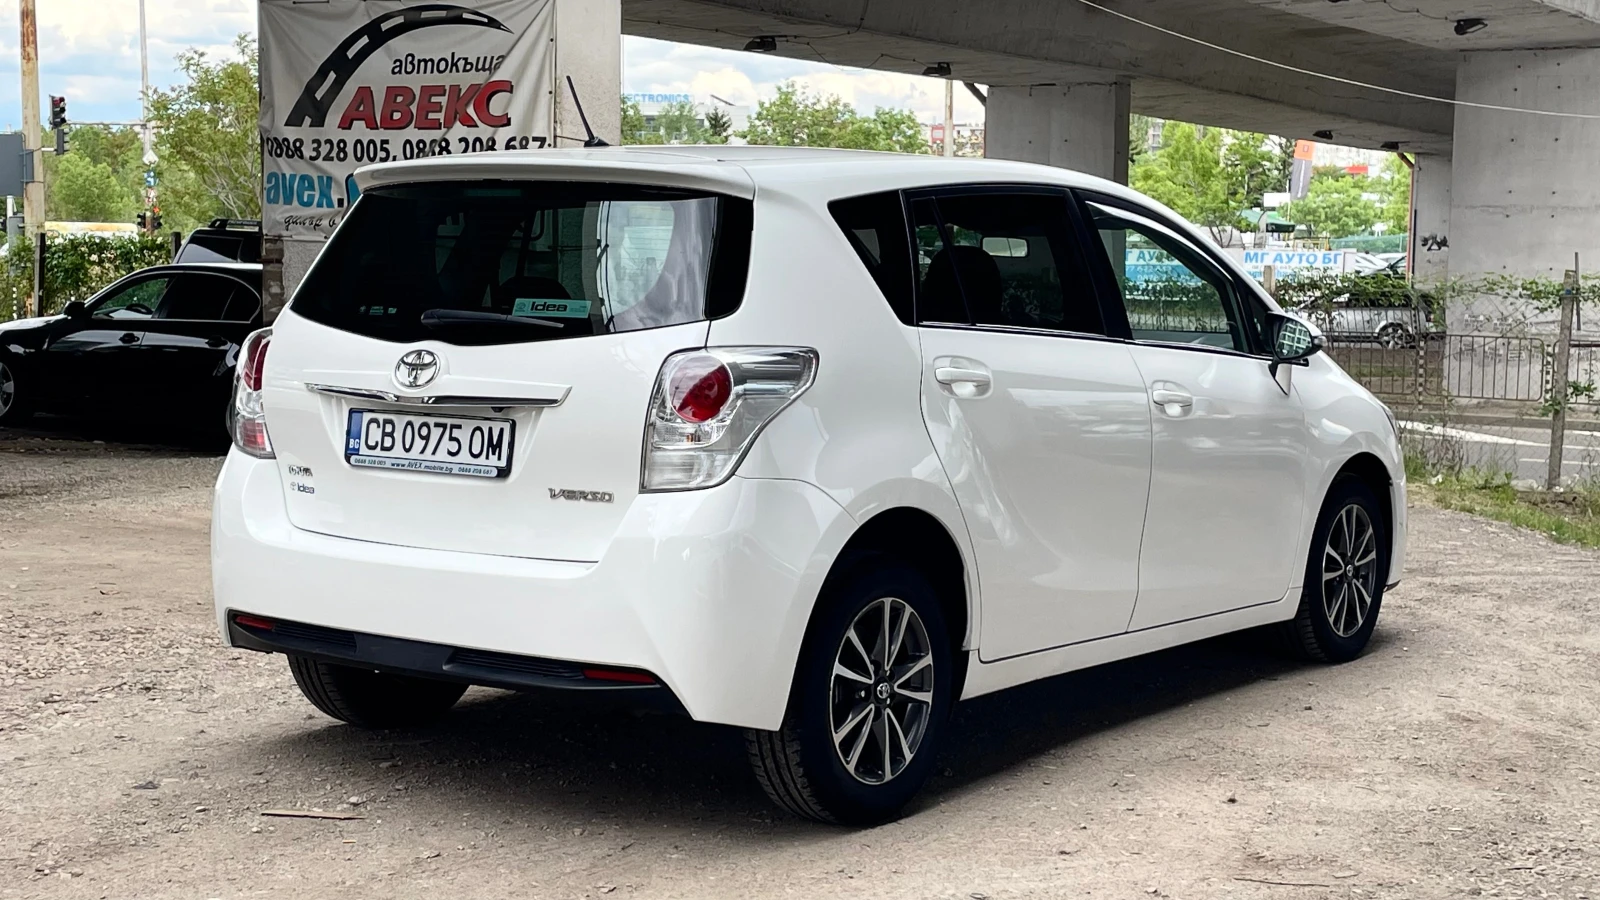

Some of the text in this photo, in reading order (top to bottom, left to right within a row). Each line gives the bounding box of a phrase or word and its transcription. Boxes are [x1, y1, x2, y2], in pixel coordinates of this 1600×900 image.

[391, 52, 506, 76] автокъща
[337, 80, 513, 130] АВЕКС
[265, 136, 304, 160] 0888
[309, 138, 348, 162] 328
[352, 138, 398, 162] 005,
[402, 137, 452, 161] 0888
[458, 136, 497, 155] 208
[1272, 252, 1318, 265] АУТО
[1322, 252, 1343, 265] БГ
[530, 301, 569, 312] Idea
[349, 438, 360, 450] BG
[364, 417, 505, 462] CB 0975 OM
[297, 482, 315, 494] Idea
[548, 487, 615, 504] VERSO
